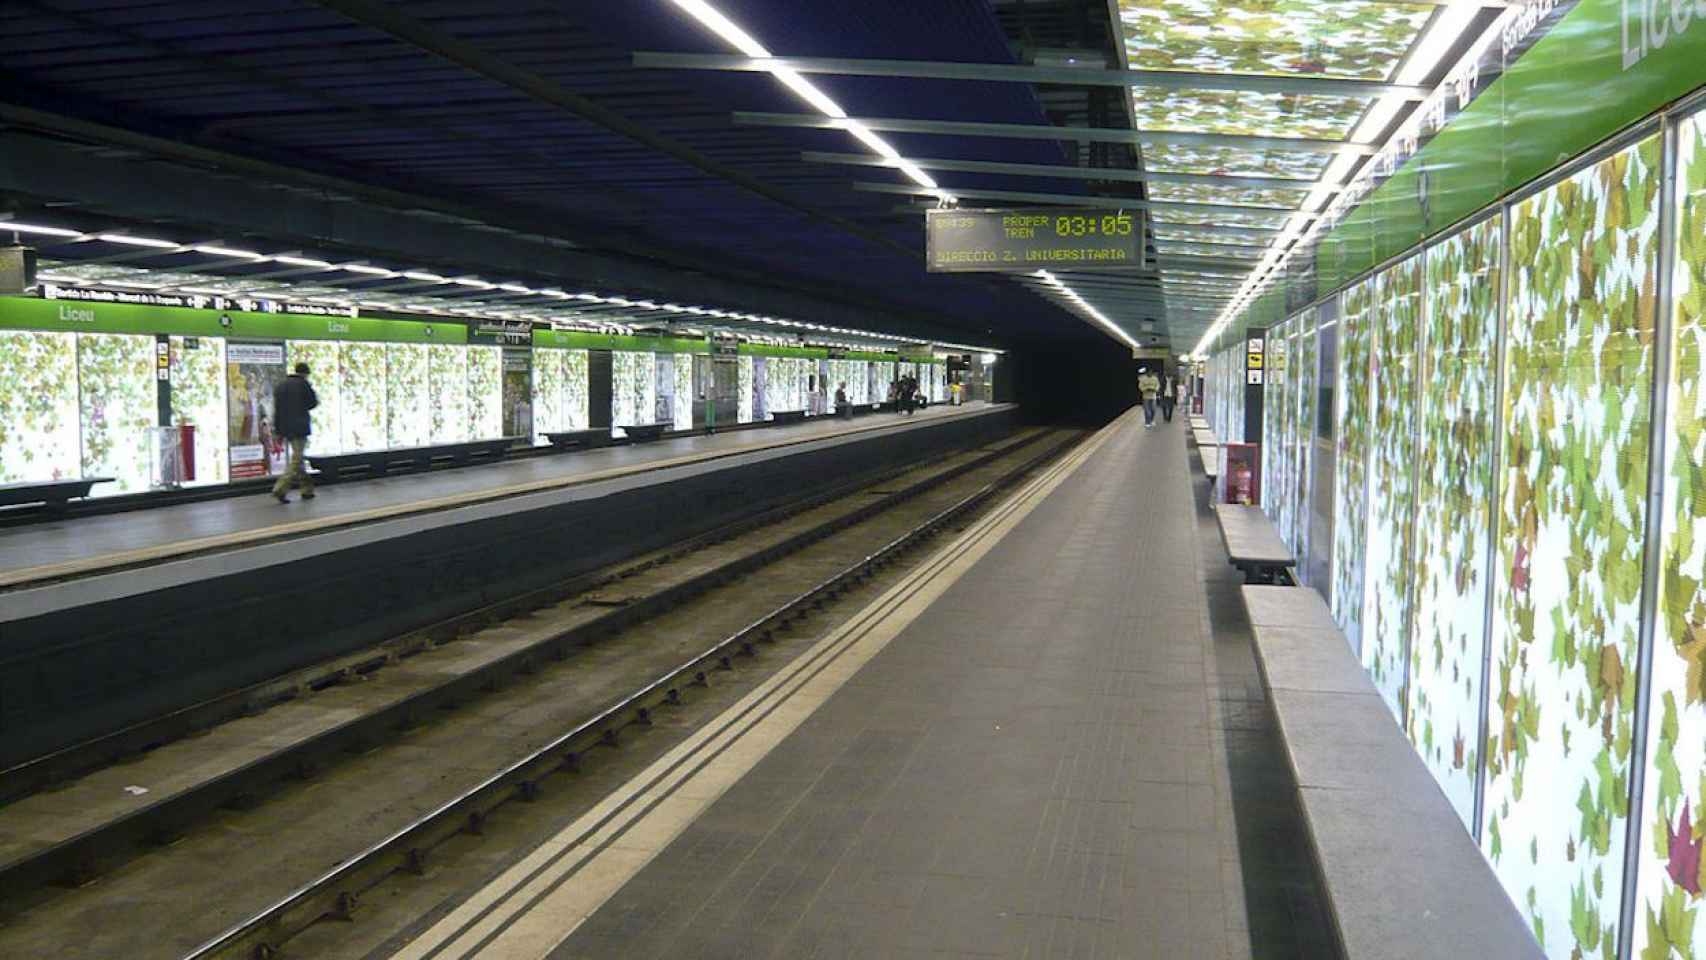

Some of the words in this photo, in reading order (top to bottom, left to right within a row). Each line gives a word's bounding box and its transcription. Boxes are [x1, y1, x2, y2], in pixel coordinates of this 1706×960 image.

[1622, 0, 1706, 71] Lice
[1005, 228, 1035, 239] TREN
[1055, 215, 1133, 236] 03:05
[1025, 249, 1126, 261] UNIVERSITARIA
[60, 305, 95, 322] Liceu
